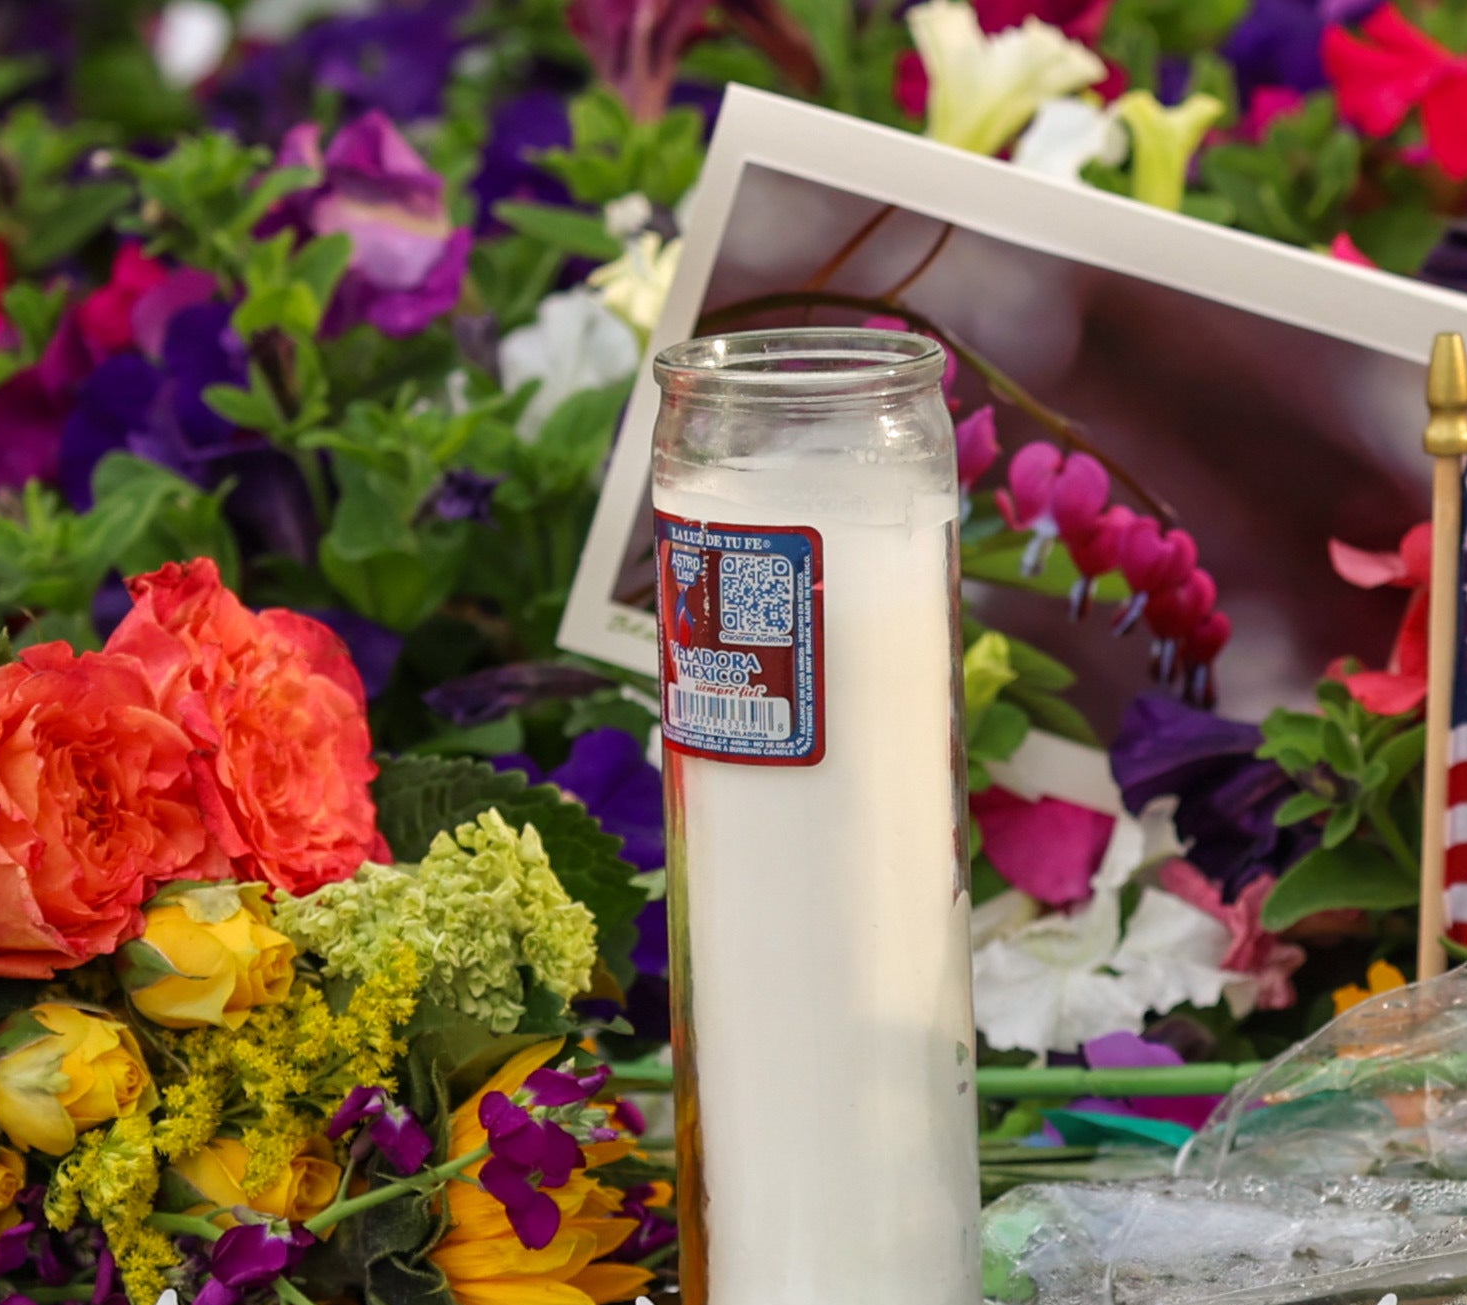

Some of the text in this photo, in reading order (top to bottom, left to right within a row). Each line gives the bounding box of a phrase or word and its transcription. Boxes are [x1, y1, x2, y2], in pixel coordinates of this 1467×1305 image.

[706, 533, 722, 547] DE
[723, 535, 741, 549] TU
[670, 551, 701, 572] ASTRO
[669, 642, 760, 671] VELADORA
[679, 664, 747, 683] MEXICO
[728, 729, 768, 738] VELADORA
[763, 747, 795, 756] CANDLE
